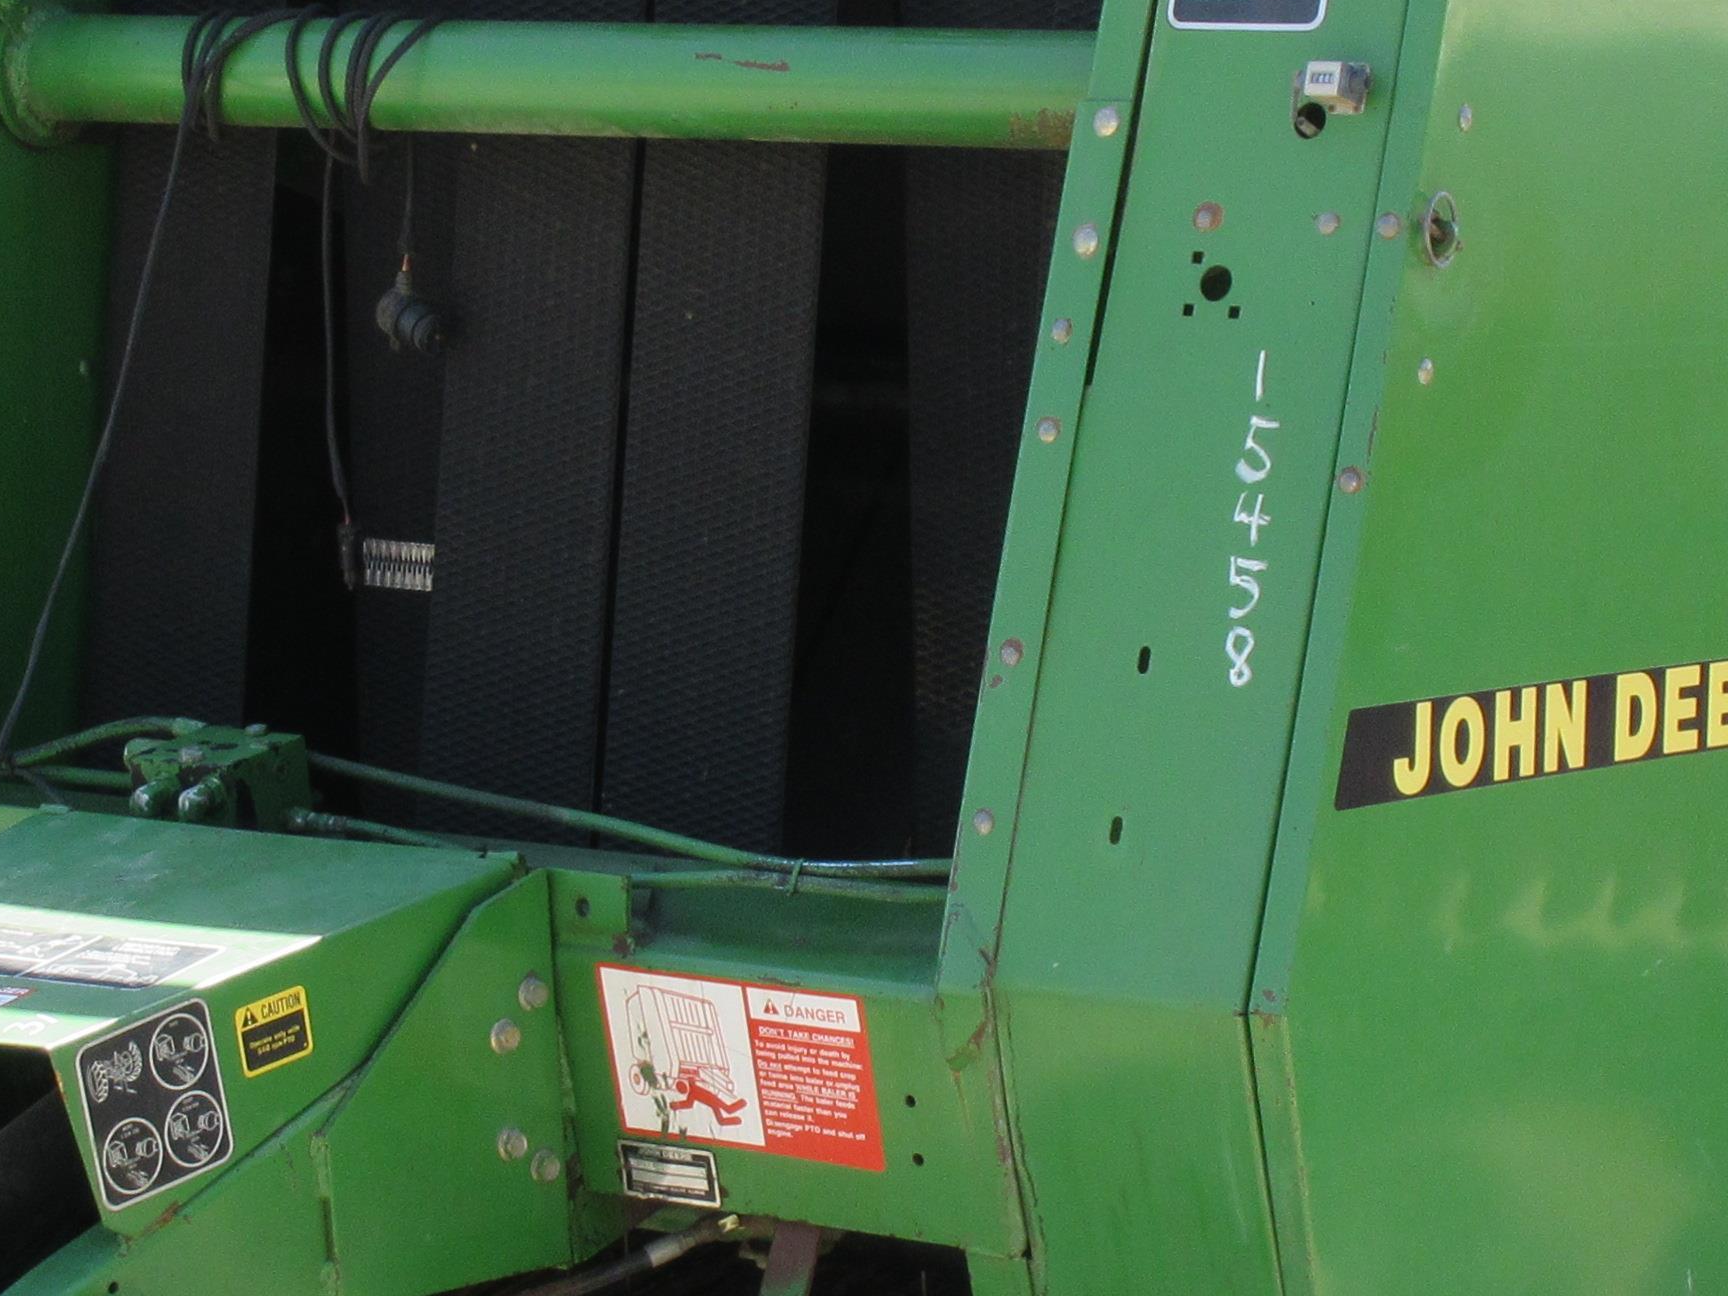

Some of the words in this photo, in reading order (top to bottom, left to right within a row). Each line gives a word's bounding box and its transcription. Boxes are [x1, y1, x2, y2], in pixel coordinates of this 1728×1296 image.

[1225, 350, 1280, 687] 15458
[1392, 680, 1588, 797] JOHN
[261, 991, 301, 1019] CAUTION
[784, 1005, 846, 1024] DANGER
[788, 1030, 810, 1040] TAKE
